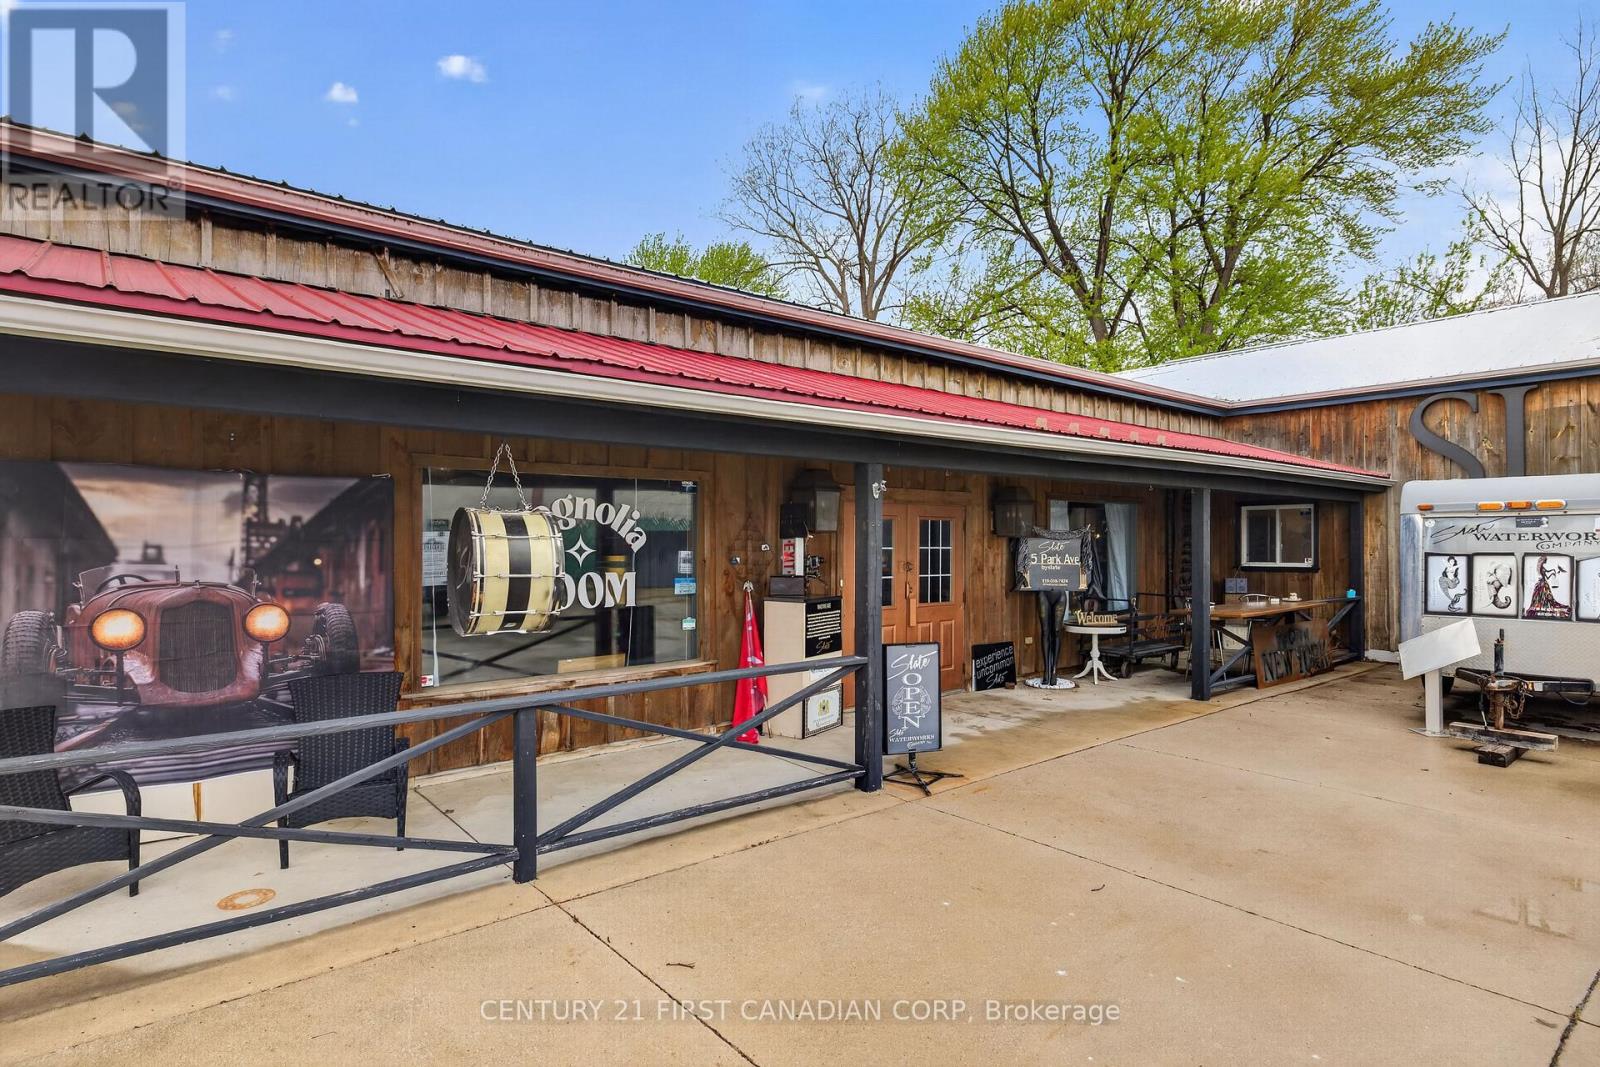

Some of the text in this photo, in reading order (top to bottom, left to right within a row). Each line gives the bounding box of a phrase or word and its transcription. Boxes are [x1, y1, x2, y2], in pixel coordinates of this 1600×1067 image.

[533, 494, 647, 553] gnolia
[1031, 553, 1038, 565] 5
[1041, 553, 1061, 565] Park
[1074, 609, 1118, 625] Welcome
[887, 650, 938, 680] Slate
[975, 645, 1013, 669] experience
[976, 656, 1013, 680] uncommon
[1262, 648, 1293, 682] NEW
[902, 673, 922, 729] OPEN
